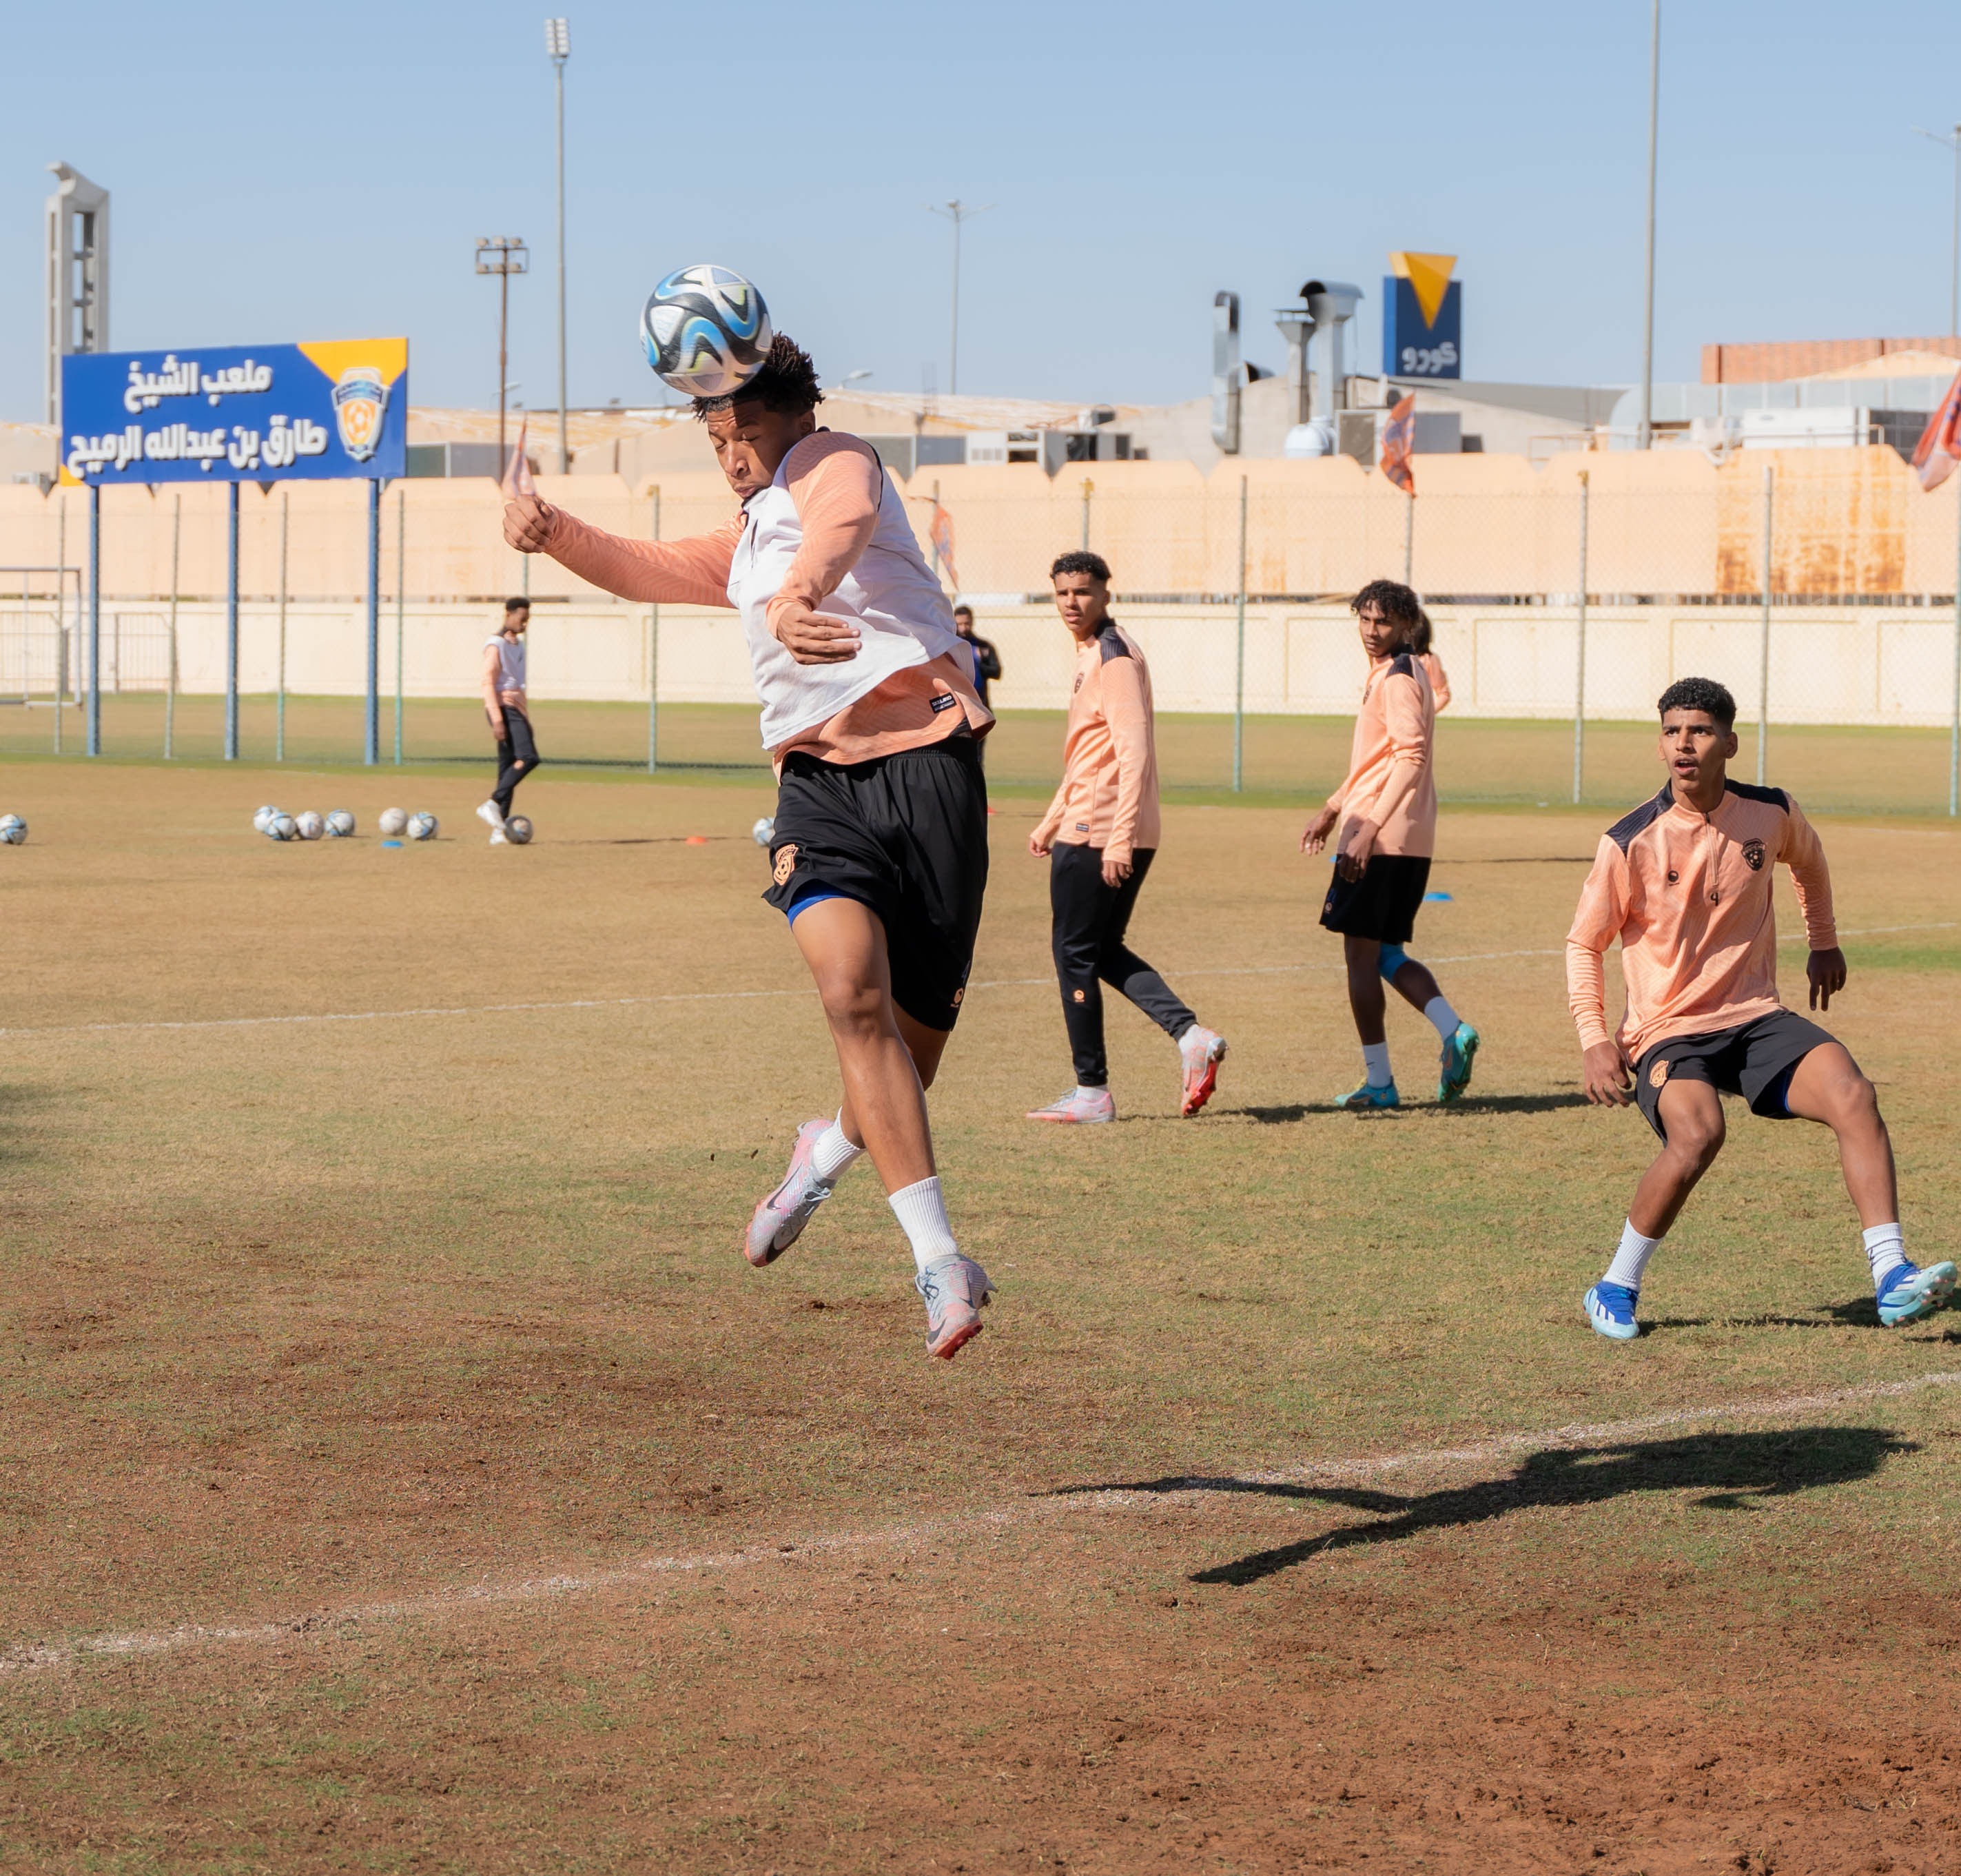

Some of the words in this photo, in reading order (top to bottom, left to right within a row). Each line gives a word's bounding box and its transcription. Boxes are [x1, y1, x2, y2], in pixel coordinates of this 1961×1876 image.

[124, 354, 198, 414] الشيخ
[201, 358, 273, 407] ملعب
[68, 425, 142, 480] الرميح
[145, 423, 226, 471] عبدالله
[228, 425, 260, 471] بن
[261, 414, 328, 468] طارق
